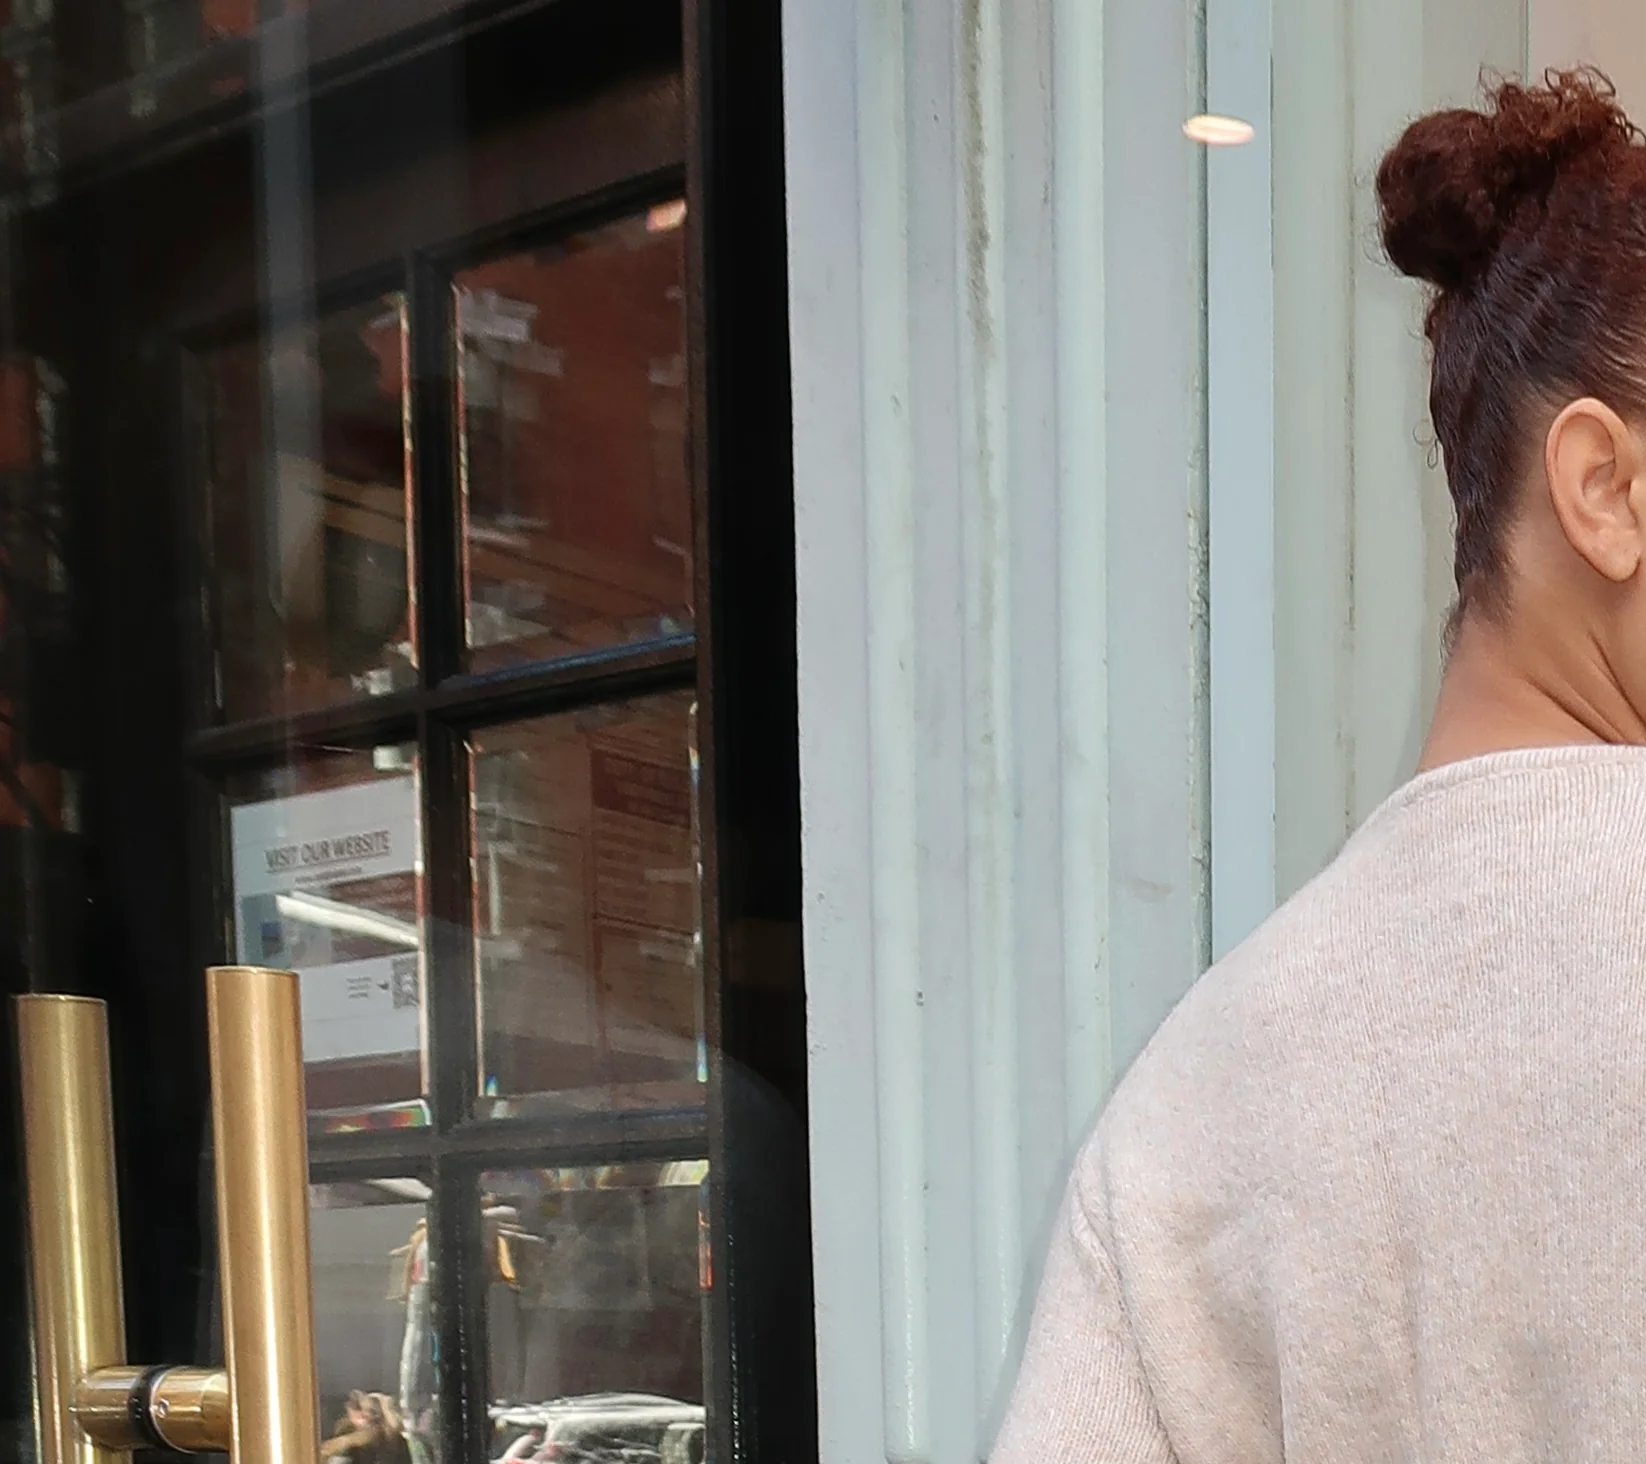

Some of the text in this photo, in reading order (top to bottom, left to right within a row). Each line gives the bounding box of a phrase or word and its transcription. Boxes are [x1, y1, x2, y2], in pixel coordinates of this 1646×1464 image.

[264, 830, 389, 868] VISIT OUR WEBSITE
